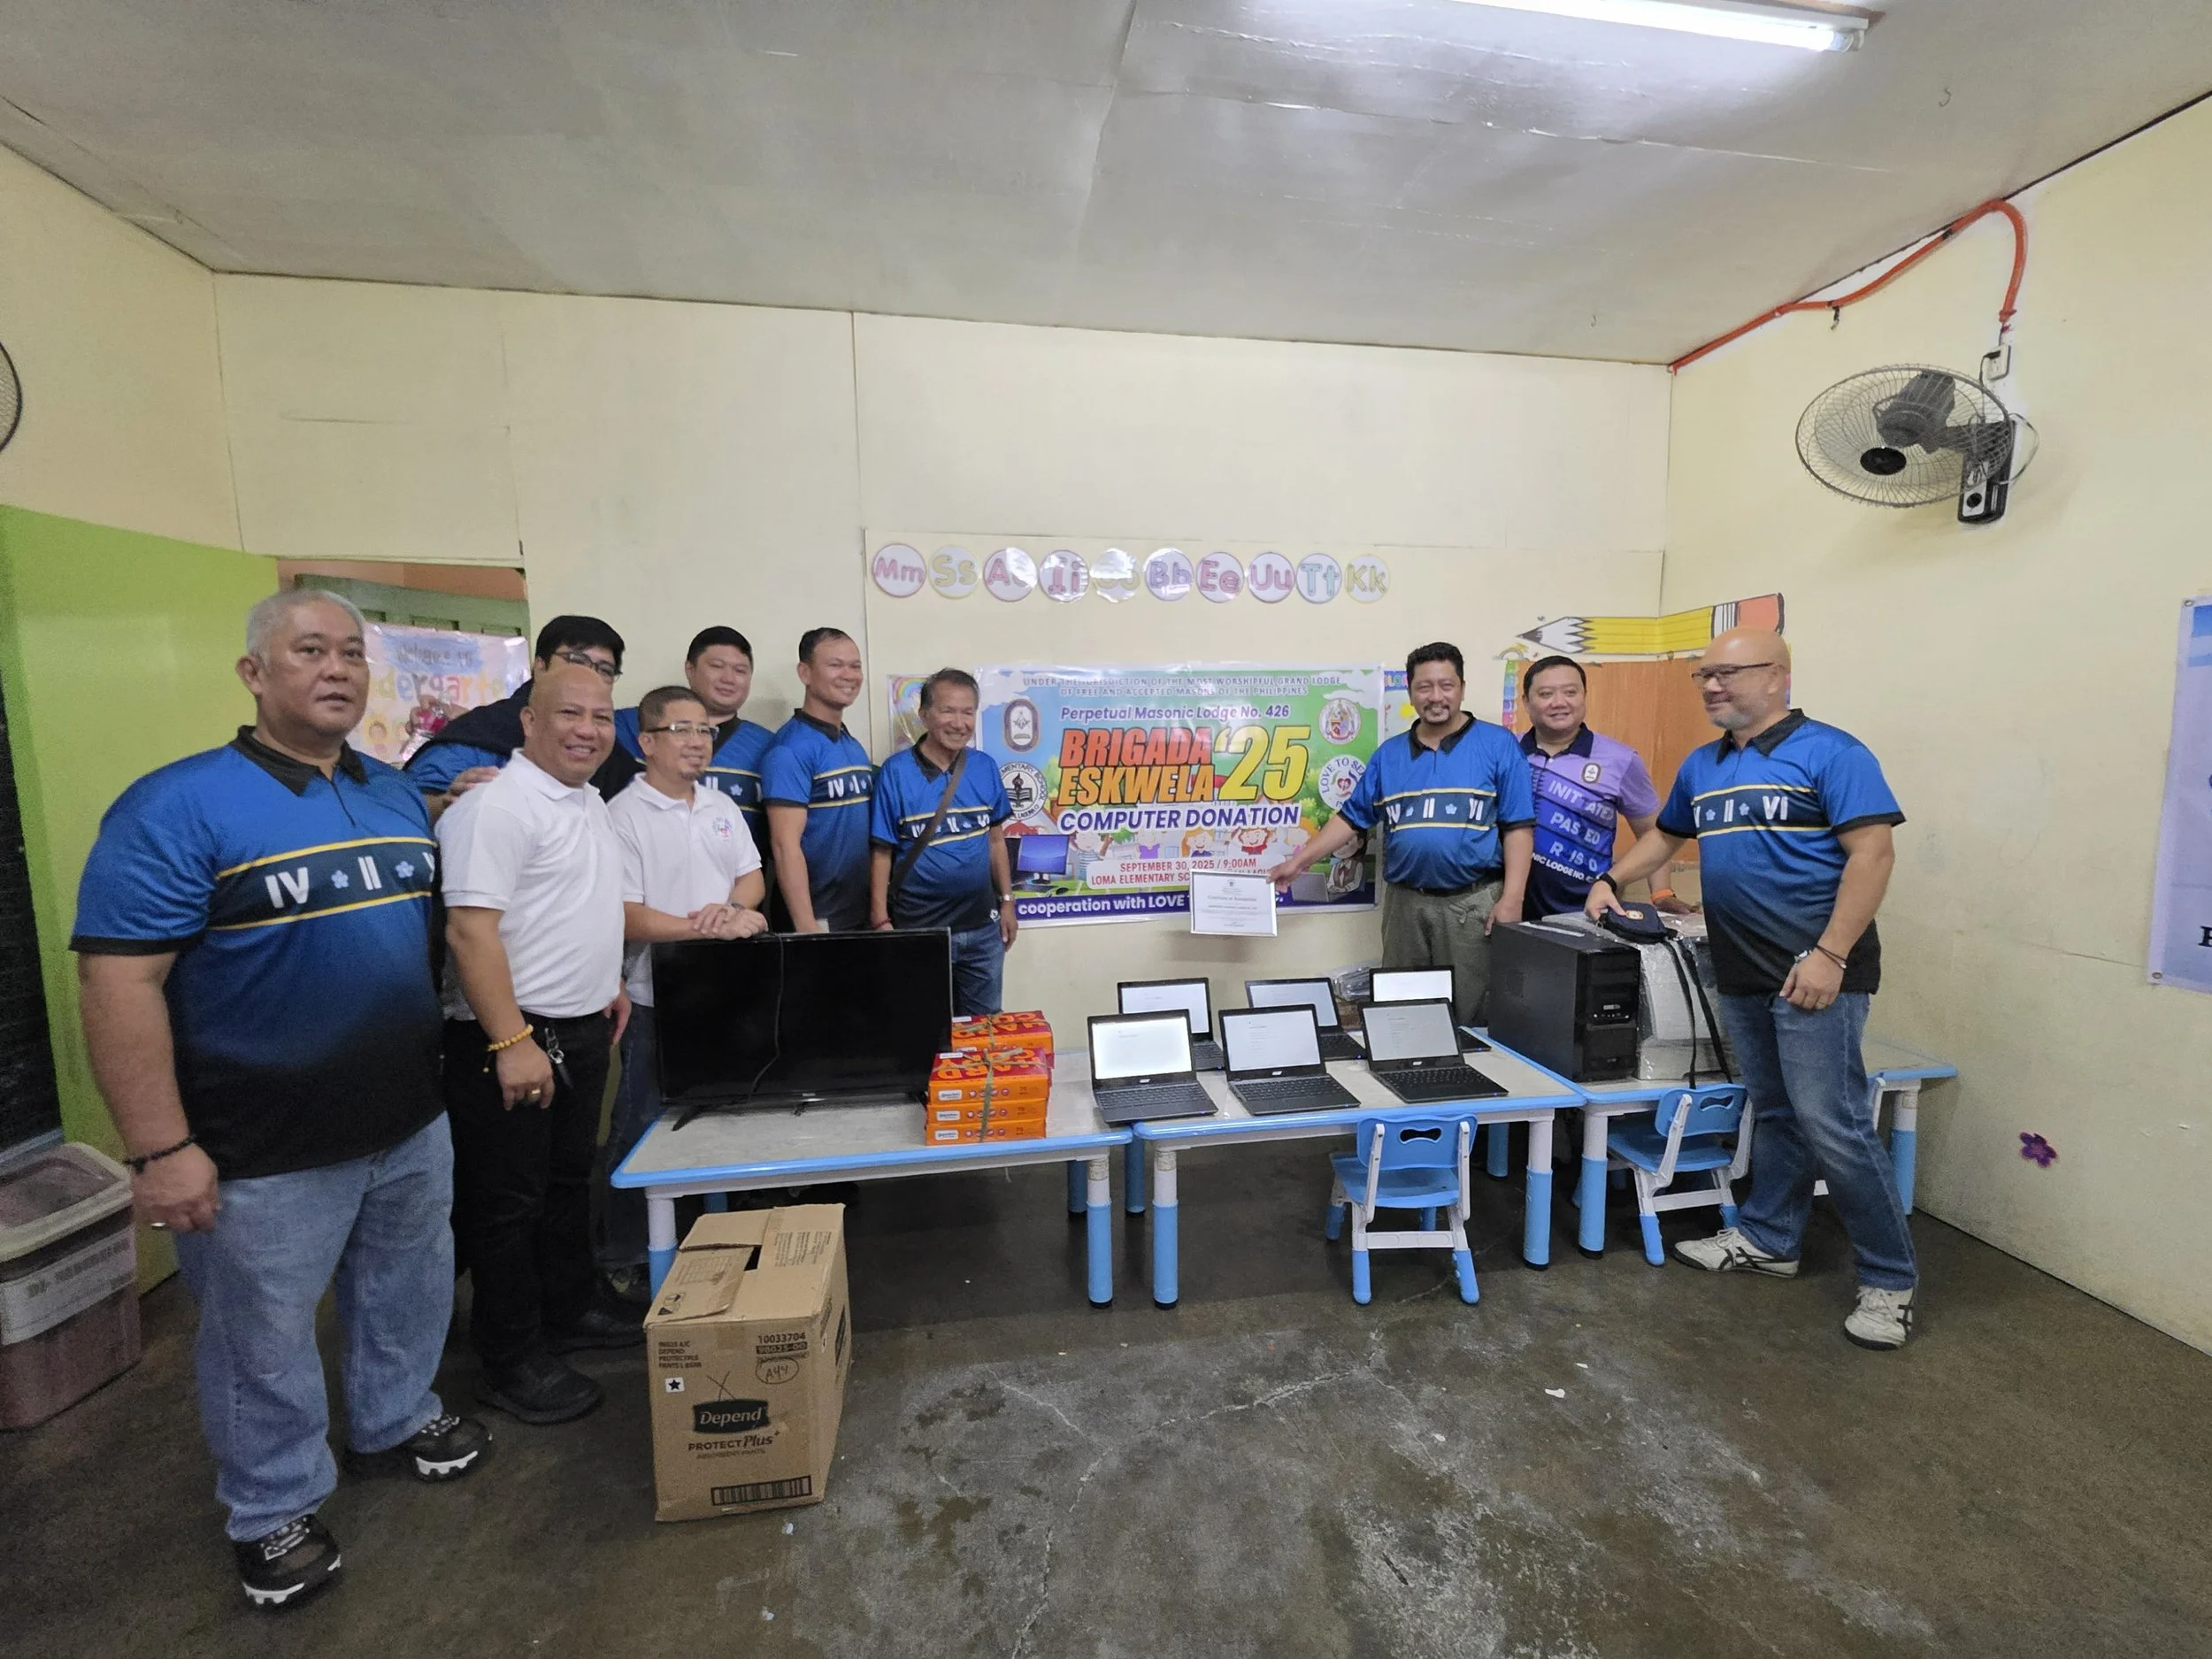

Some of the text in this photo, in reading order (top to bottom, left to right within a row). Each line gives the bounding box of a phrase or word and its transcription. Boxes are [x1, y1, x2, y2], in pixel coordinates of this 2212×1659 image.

[873, 557, 925, 584] Mm
[933, 555, 978, 588] Ss
[1150, 561, 1192, 588] Bb
[1200, 560, 1240, 594] Ee
[1250, 564, 1293, 591] Uu
[1301, 563, 1340, 596] Tt
[1345, 564, 1387, 594] Kk
[1217, 677, 1273, 686] WORSHIPFUL
[1062, 705, 1289, 724] Perpetual Masonic Lodge No. 426
[1058, 726, 1213, 767] BRIGADA
[1056, 764, 1215, 806] ESKWELA
[1320, 764, 1335, 793] LOVE
[1334, 757, 1349, 767] TO
[1386, 803, 1401, 825] IV
[1423, 798, 1435, 818] II
[1548, 780, 1614, 821] INITATED
[1724, 799, 1734, 823] II
[1763, 795, 1788, 820] VI
[1061, 806, 1300, 831] COMPUTER DONATION
[1549, 811, 1601, 845] PASED
[1091, 873, 1116, 885] LOMA
[1119, 872, 1174, 884] ELEMENTARY
[1120, 861, 1172, 872] SEPTEMBER
[1175, 861, 1190, 872] 30,
[1192, 859, 1214, 869] 2025
[1223, 858, 1256, 868] 9:00AM
[1546, 858, 1574, 876] LODGE
[265, 866, 309, 909] IV
[357, 856, 382, 890] II
[1018, 897, 1111, 918] cooperation
[1118, 896, 1146, 910] with
[1148, 895, 1185, 909] LOVE
[700, 1407, 762, 1427] Depend
